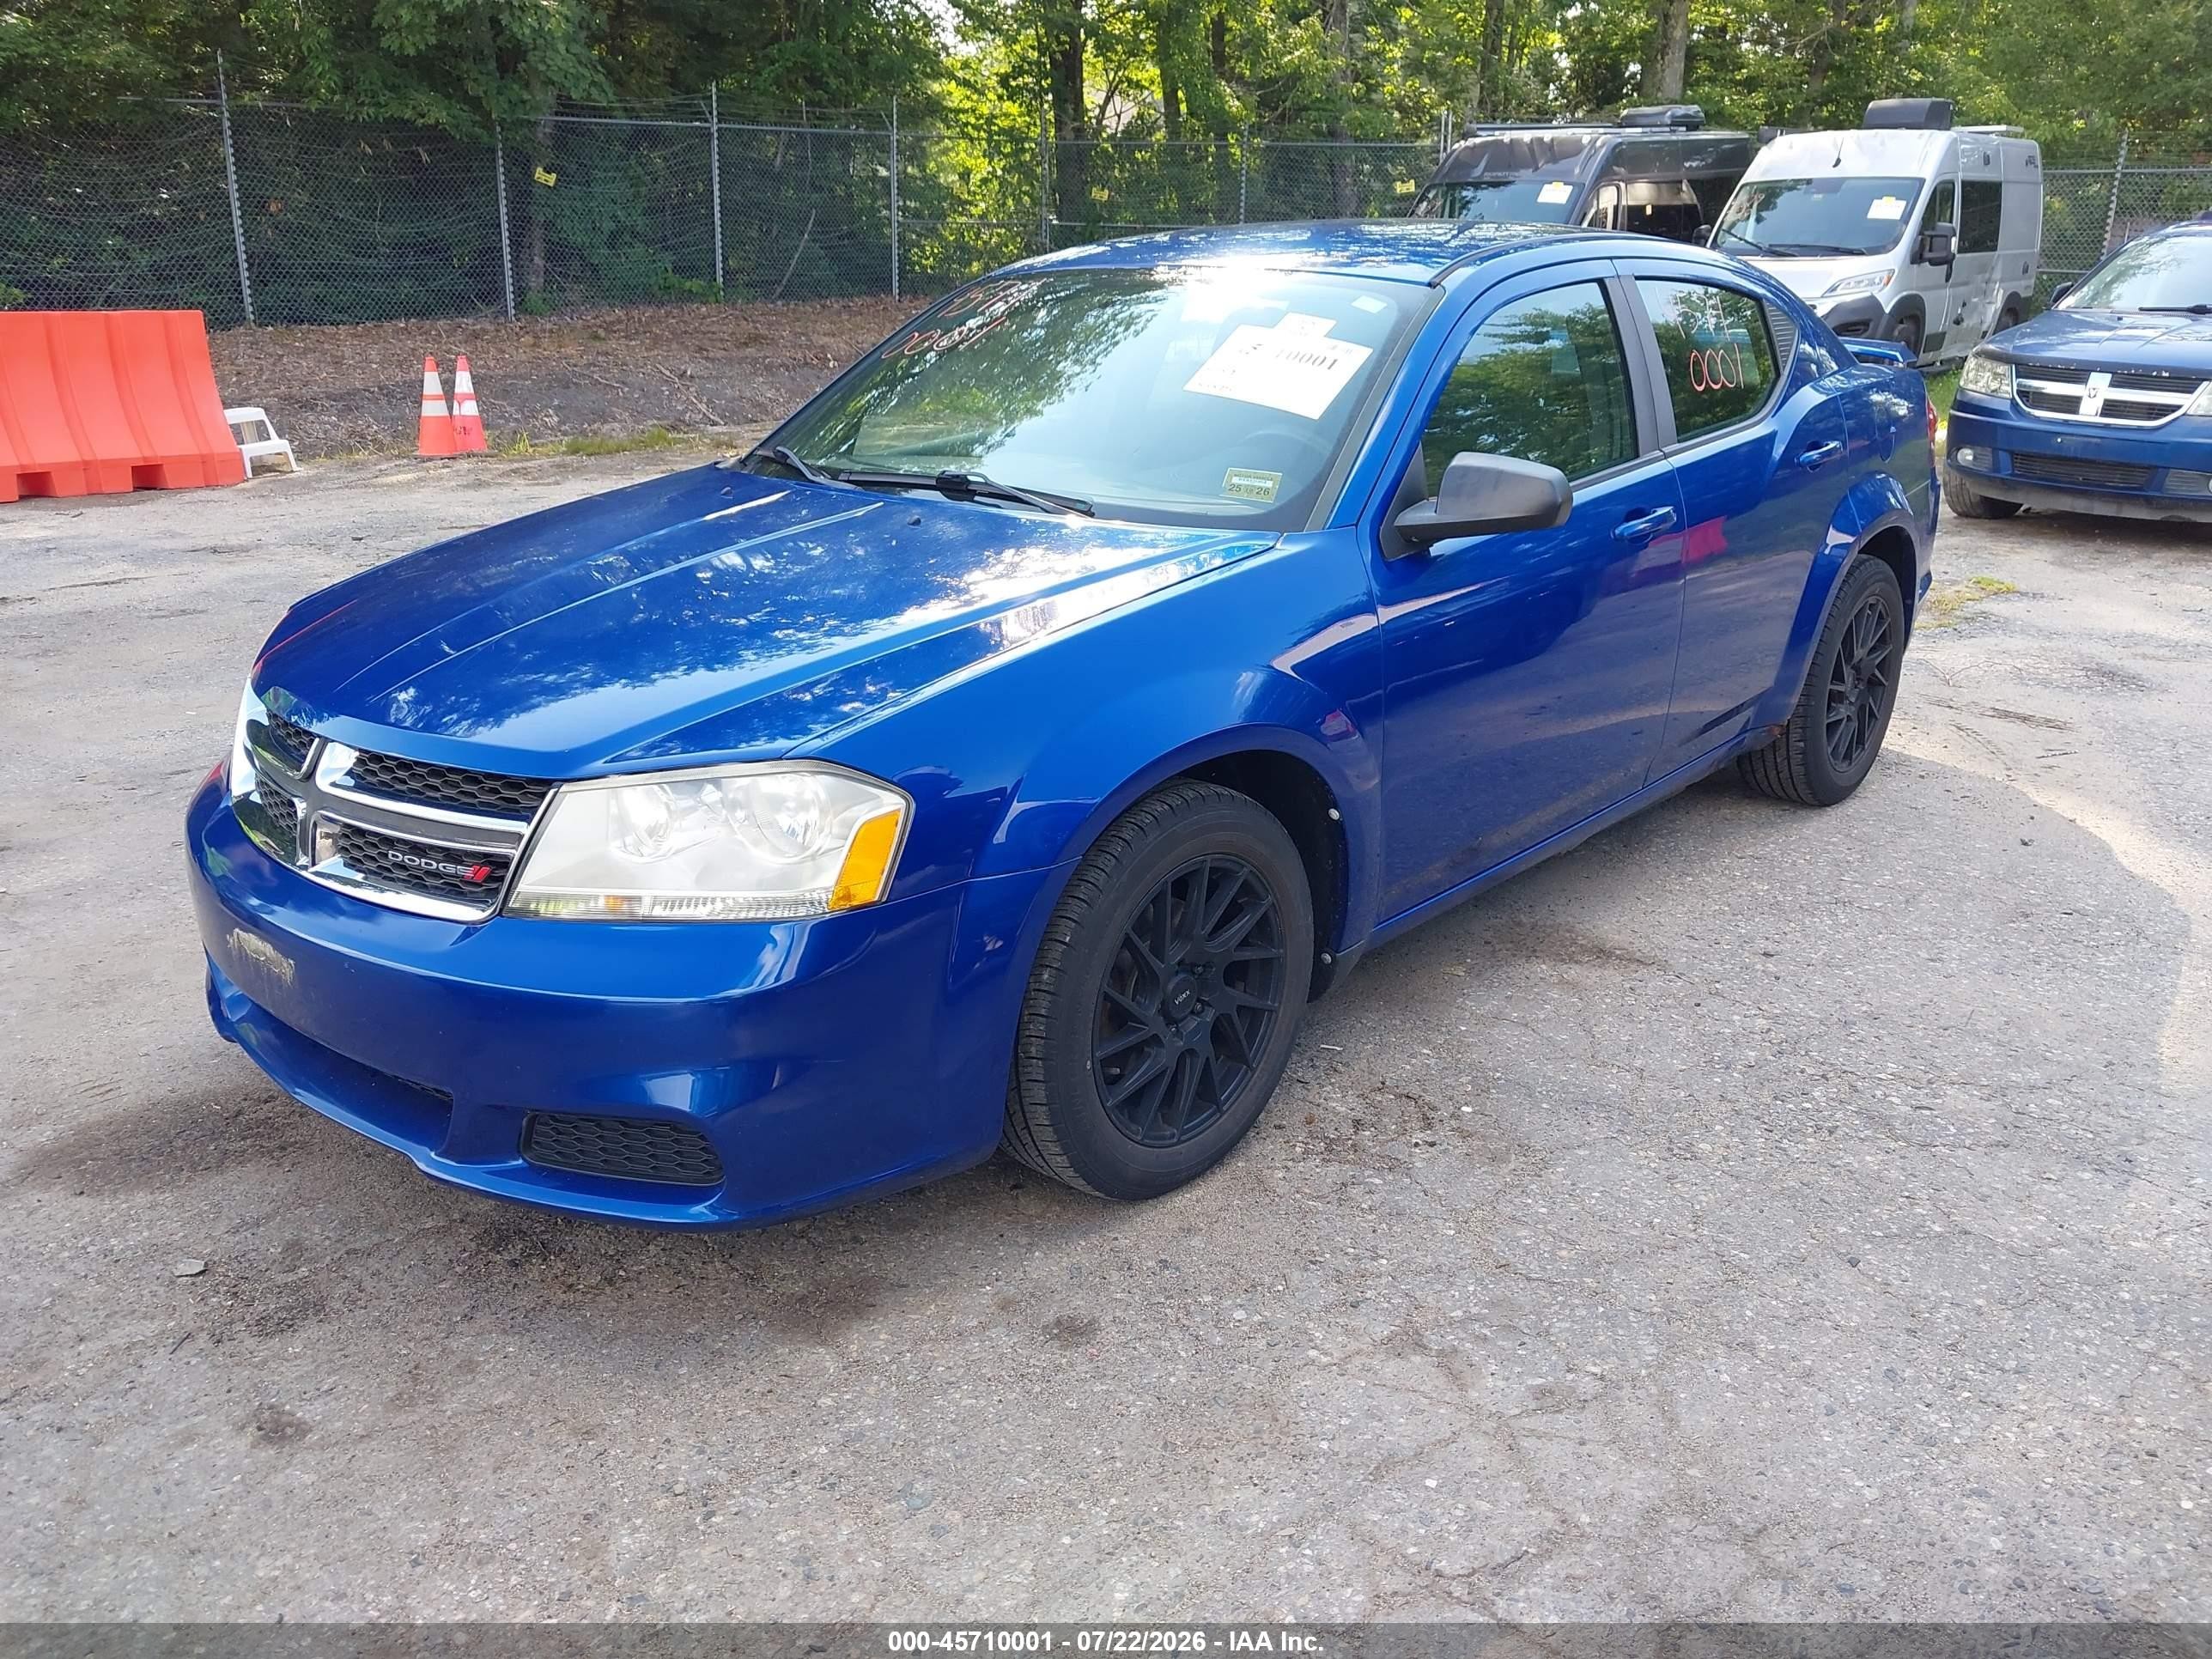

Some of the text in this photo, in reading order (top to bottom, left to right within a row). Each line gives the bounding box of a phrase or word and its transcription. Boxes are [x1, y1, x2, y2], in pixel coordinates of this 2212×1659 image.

[1690, 343, 1744, 392] 0001
[1228, 483, 1270, 495] 25 26
[387, 850, 475, 877] DODGE
